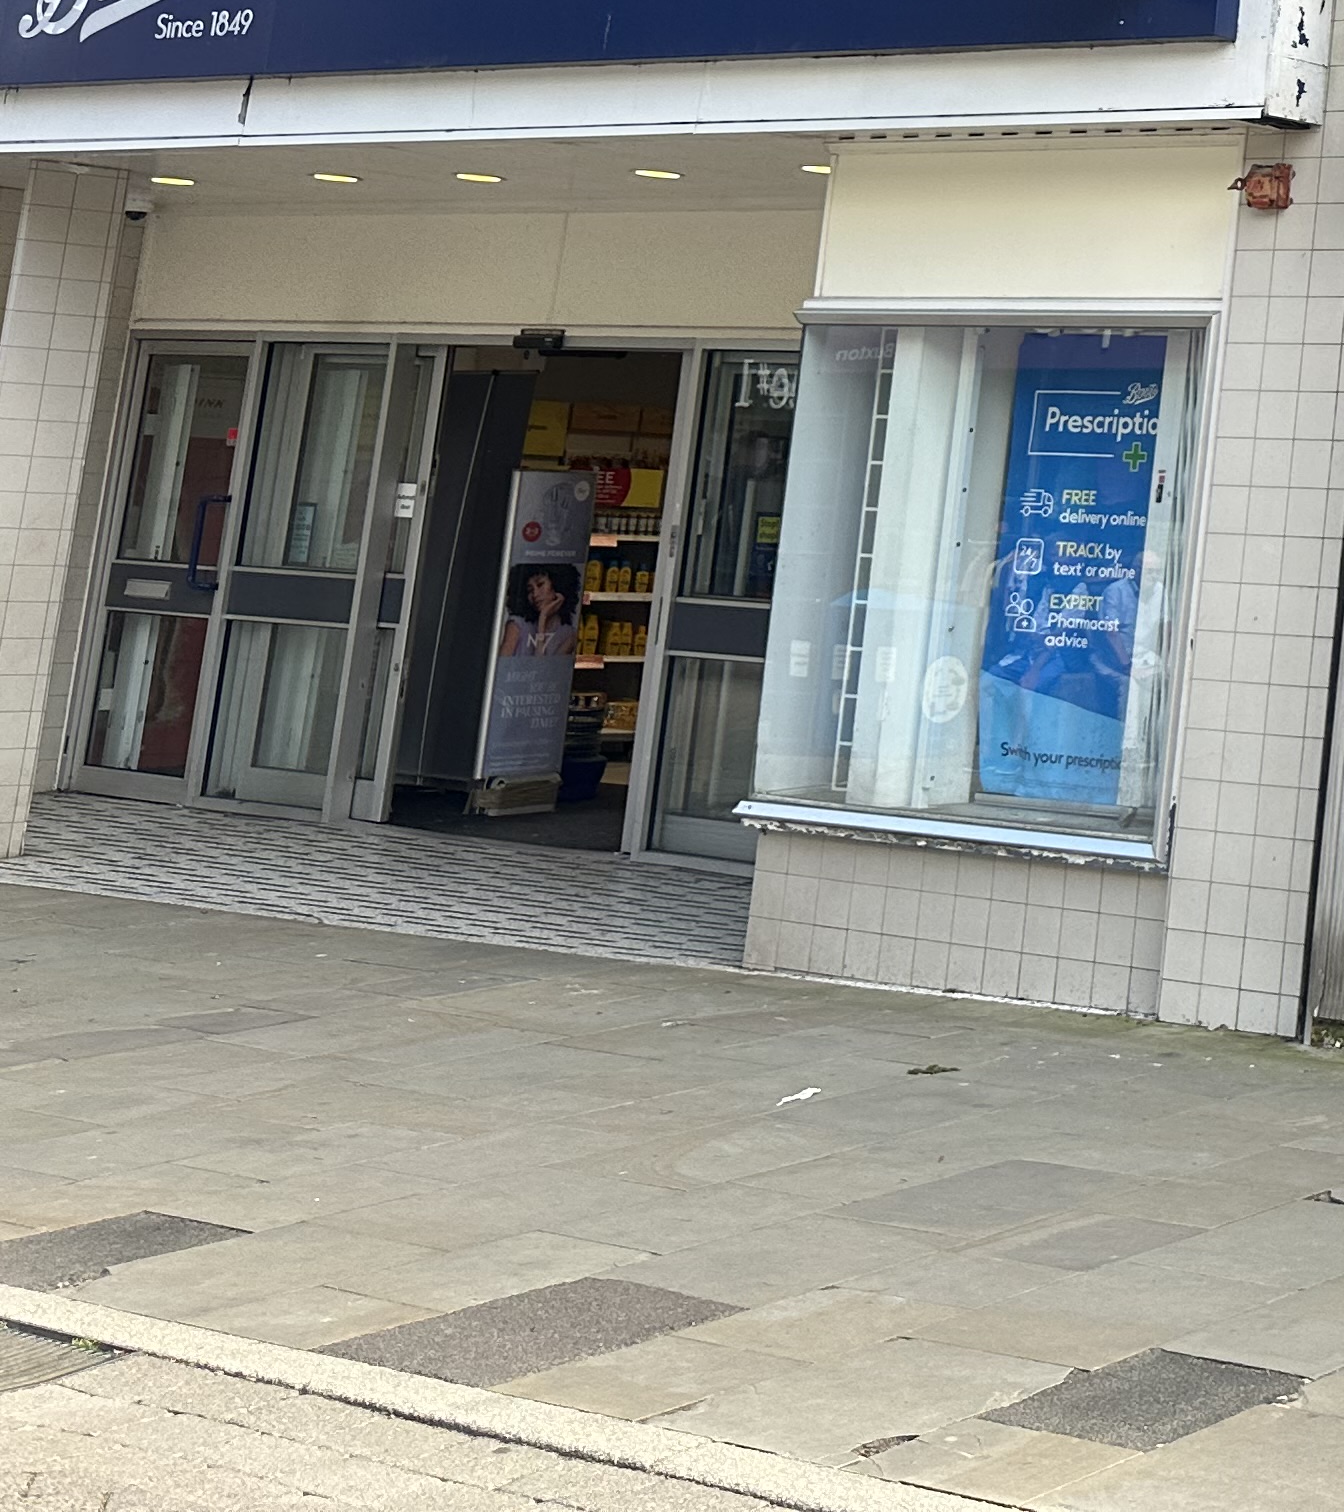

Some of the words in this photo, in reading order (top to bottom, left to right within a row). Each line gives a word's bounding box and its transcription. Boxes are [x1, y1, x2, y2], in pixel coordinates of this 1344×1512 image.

[154, 13, 204, 41] Since
[210, 9, 254, 37] 1849
[1062, 489, 1097, 506] FREE
[1058, 509, 1110, 529] delivery
[1111, 511, 1147, 528] online
[1057, 541, 1103, 559] TRACK
[1104, 544, 1122, 564] by
[1099, 564, 1136, 580] online
[1050, 593, 1103, 612] EXPERT
[1047, 613, 1120, 634] Pharmacist
[1045, 632, 1088, 648] advice
[1033, 751, 1064, 768] your
